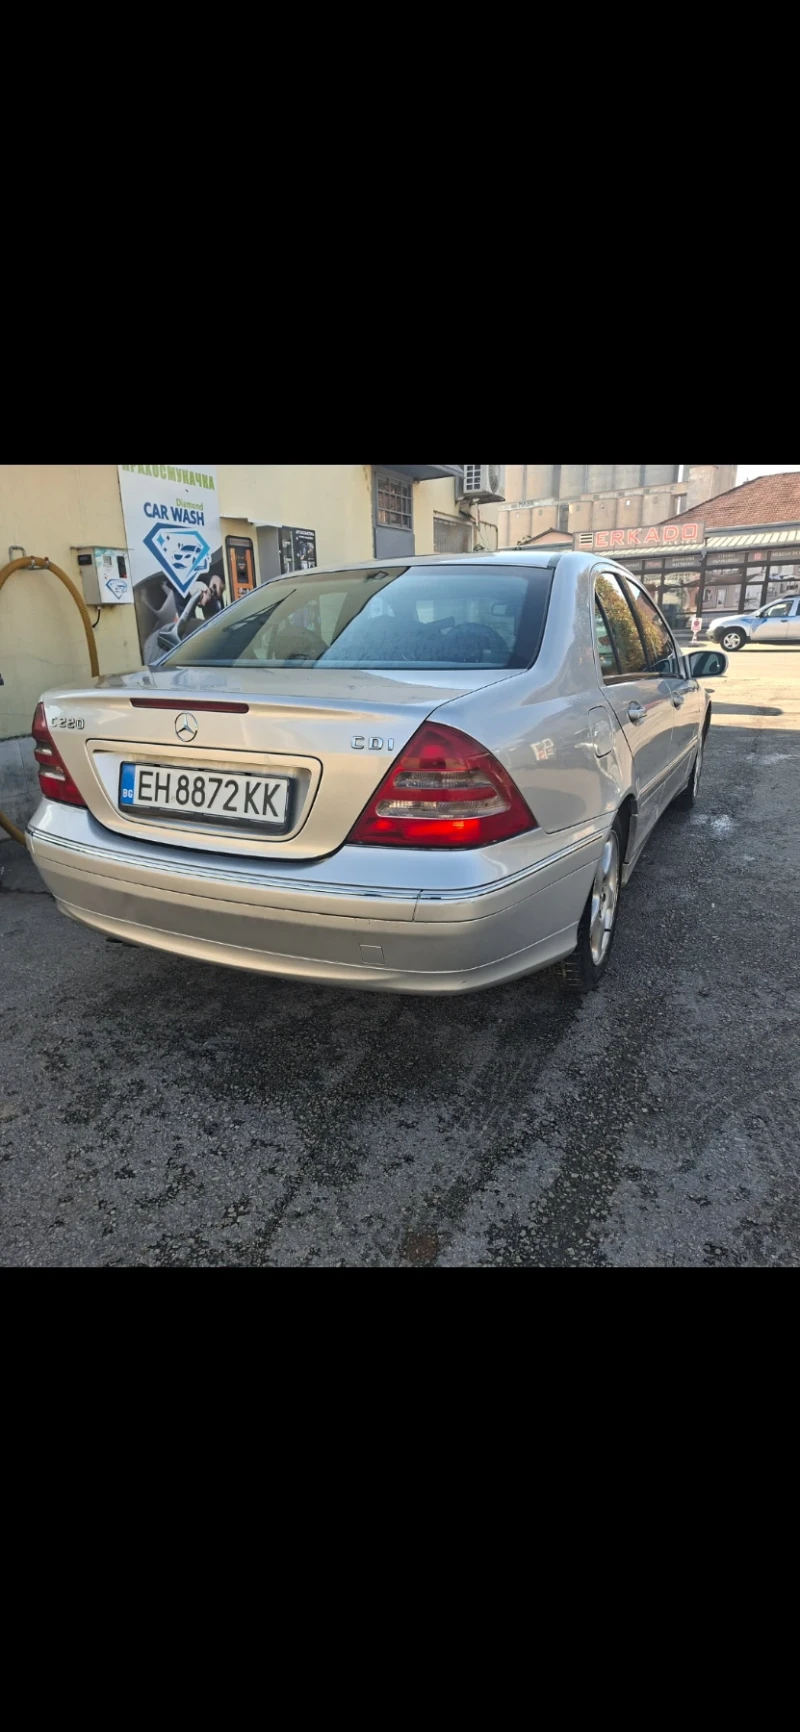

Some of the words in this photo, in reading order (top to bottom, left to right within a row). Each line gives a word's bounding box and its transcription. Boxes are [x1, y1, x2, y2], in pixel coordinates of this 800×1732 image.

[175, 498, 204, 511] Diamond
[143, 501, 170, 521] CAR
[170, 506, 205, 526] WASH
[594, 523, 699, 548] ERKADO
[351, 735, 394, 751] CDI
[122, 788, 134, 799] BG
